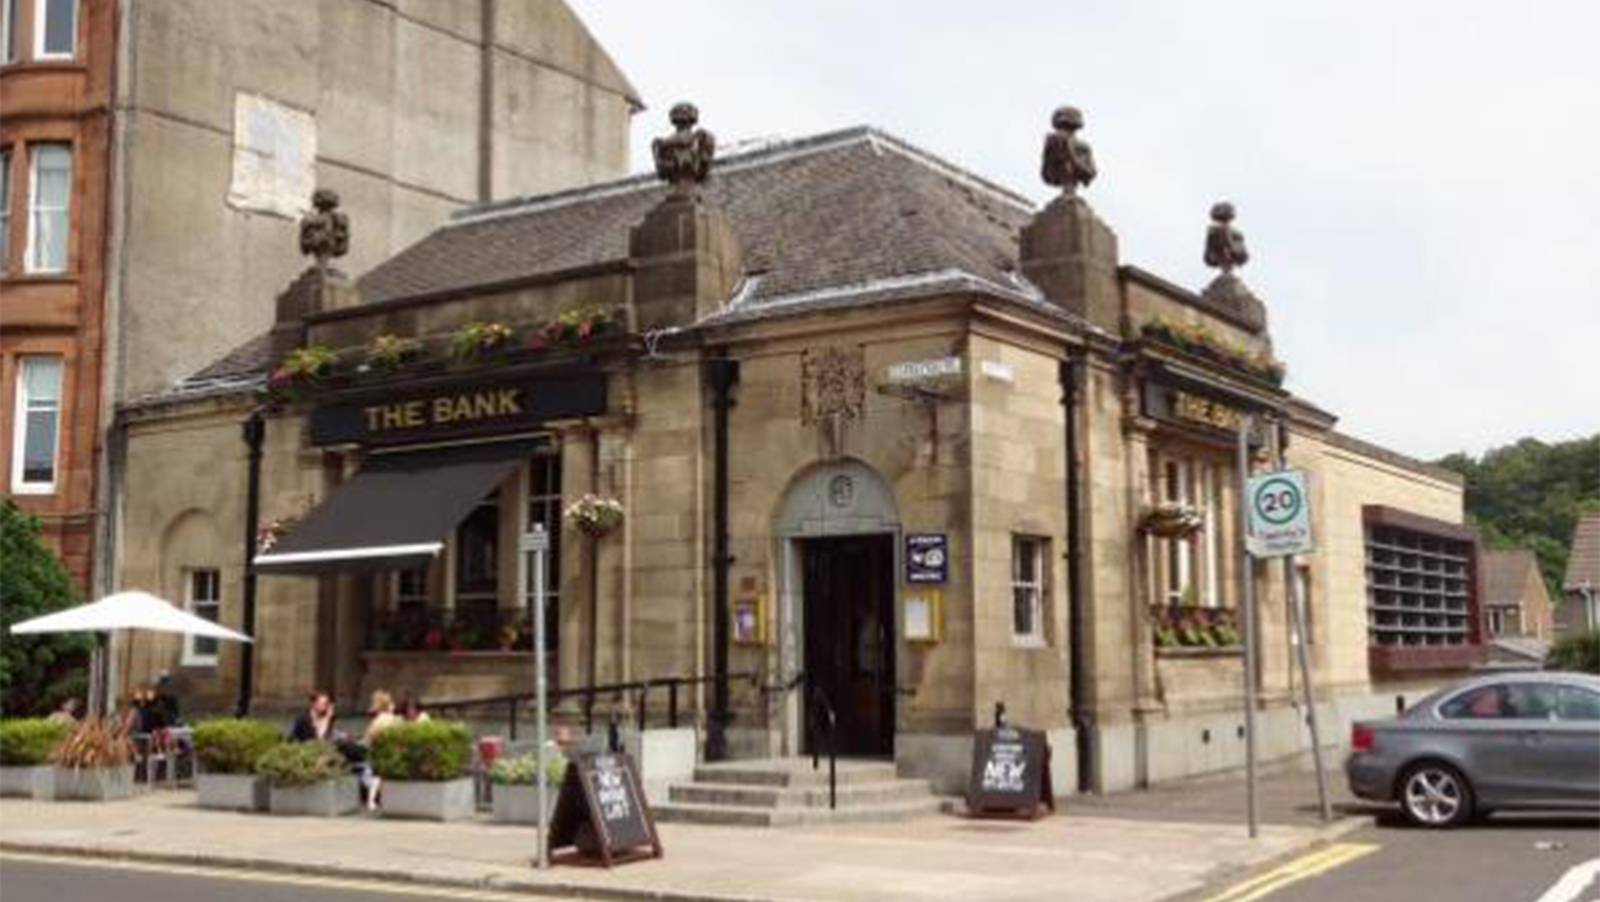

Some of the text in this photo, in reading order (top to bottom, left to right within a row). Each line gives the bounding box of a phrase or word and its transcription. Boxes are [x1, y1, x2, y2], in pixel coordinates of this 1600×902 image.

[364, 388, 523, 430] THE BANK
[1175, 391, 1210, 422] THE
[1263, 490, 1293, 512] 20
[984, 760, 1026, 783] NEW
